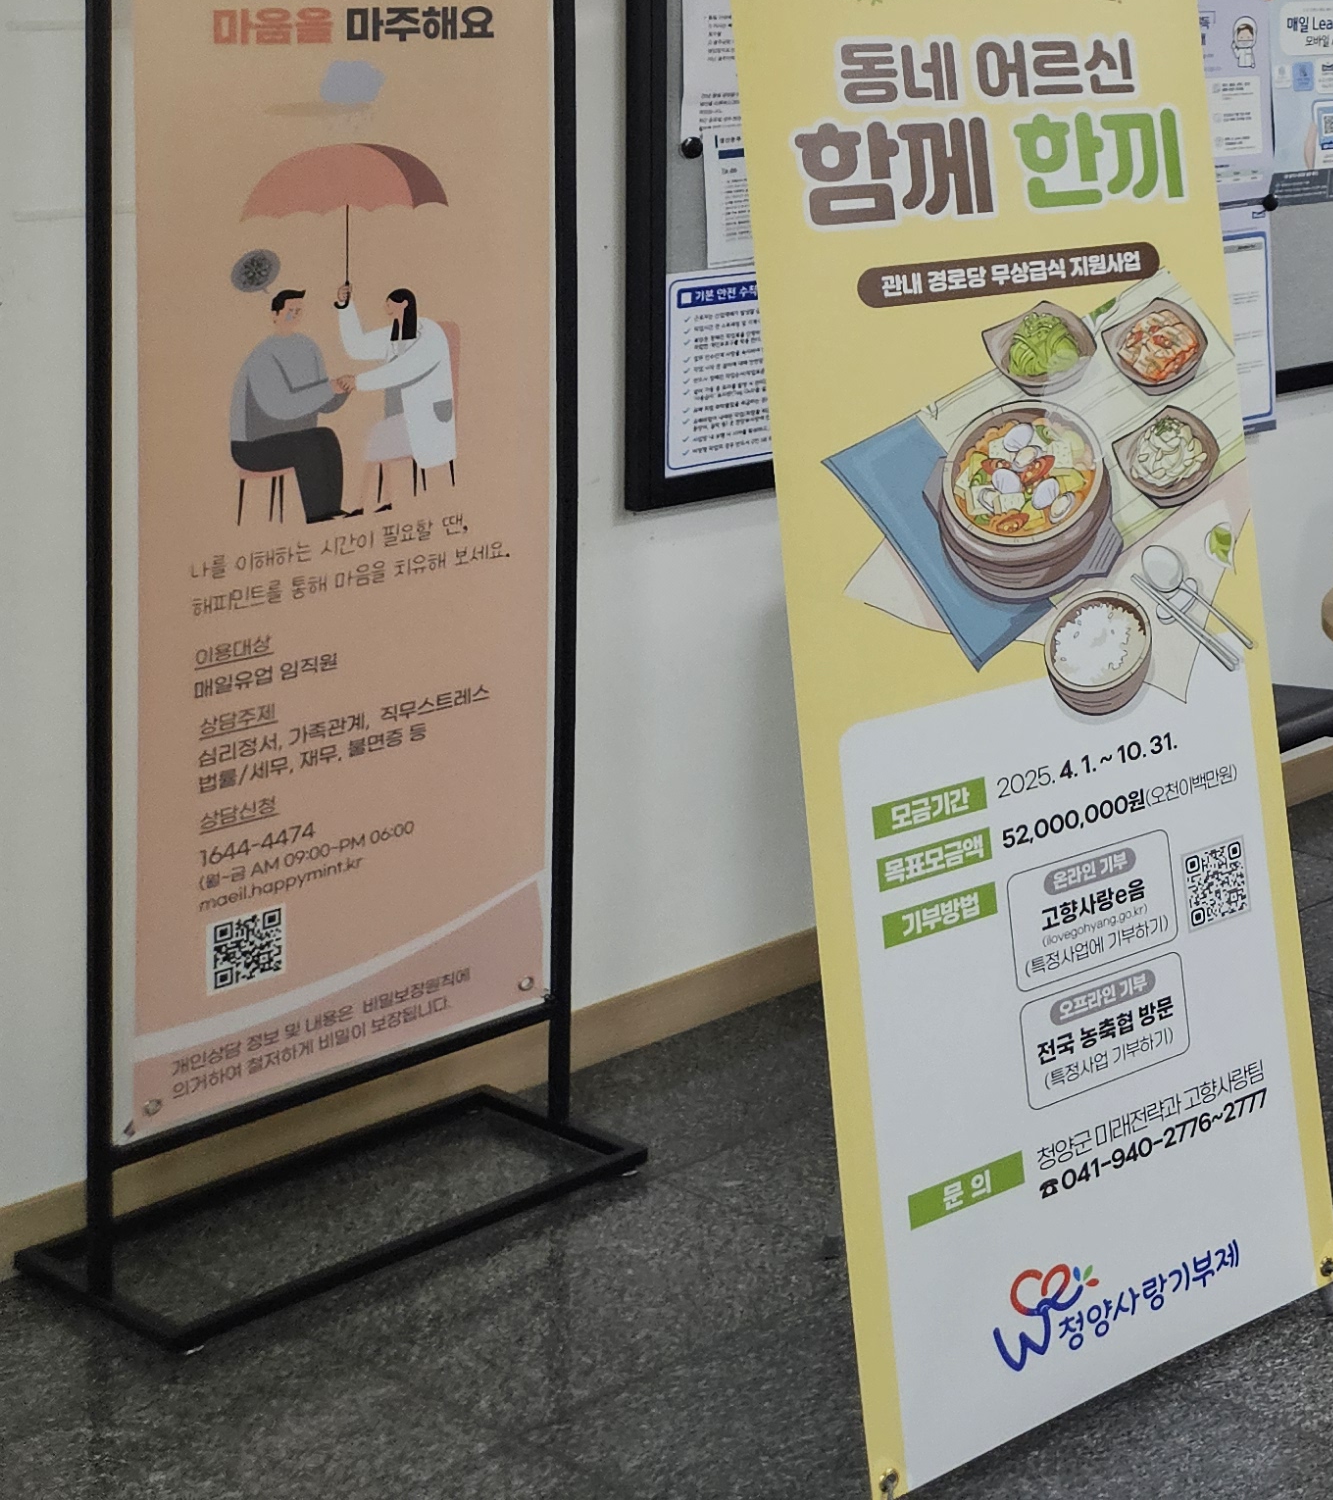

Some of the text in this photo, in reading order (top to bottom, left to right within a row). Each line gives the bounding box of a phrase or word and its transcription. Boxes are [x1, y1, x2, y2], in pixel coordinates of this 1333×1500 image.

[213, 5, 494, 45] 마음을 마주해요
[1287, 16, 1309, 33] 매일
[1305, 35, 1330, 47] 모바일
[840, 38, 1135, 105] 동네 어르신
[794, 108, 1184, 226] 함께 한끼
[695, 289, 714, 301] 기본
[717, 287, 737, 300] 안전
[880, 250, 1142, 298] 관내 경로당 무상급식 지원사업
[191, 554, 226, 579] 나를
[234, 542, 311, 572] 이해하는
[320, 531, 373, 556] 시간이
[382, 520, 433, 547] 필요할
[192, 541, 511, 616] 해피민트를 통해 마음을 치유해 보세요.
[196, 634, 272, 666] 이용대상
[194, 652, 339, 699] 매일유업 임직원
[198, 684, 491, 768] 심리정서, 가족관계, 직무스트레스
[200, 703, 276, 736] 상담주제
[198, 722, 427, 794] 법률/세무, 재무, 불면증 등
[997, 765, 1056, 799] 2025.
[200, 795, 277, 830] 상담신청
[891, 786, 970, 831] 모금기간
[199, 822, 316, 867] 1644-4474
[250, 857, 280, 878] AM
[370, 820, 416, 844] 06:00
[884, 834, 985, 884] 목표모금액
[199, 857, 364, 912] maeil.happymint.kr
[1052, 851, 1128, 889] 온라인 기부
[902, 892, 980, 937] 기부방법
[1041, 879, 1145, 931] 고향사랑e음
[1042, 903, 1148, 947] (ilovegohyang.go.kr)
[1025, 915, 1169, 978] (특정사업에 기부하기)
[171, 966, 471, 1077] 개인상담 정보 및 내용은 비밀보장원칙에
[1059, 973, 1148, 1020] 오프라인 기부
[172, 995, 452, 1099] 의거하여 철저하게 비밀이 보장됩니다.
[1037, 995, 1174, 1065] 전국 농축협 방문
[1044, 1027, 1174, 1090] (특정사업 기부하기)
[1037, 1060, 1265, 1171] 청양군 미래전략과 고향사랑팀
[1059, 1239, 1240, 1350] 청양사랑기부제
